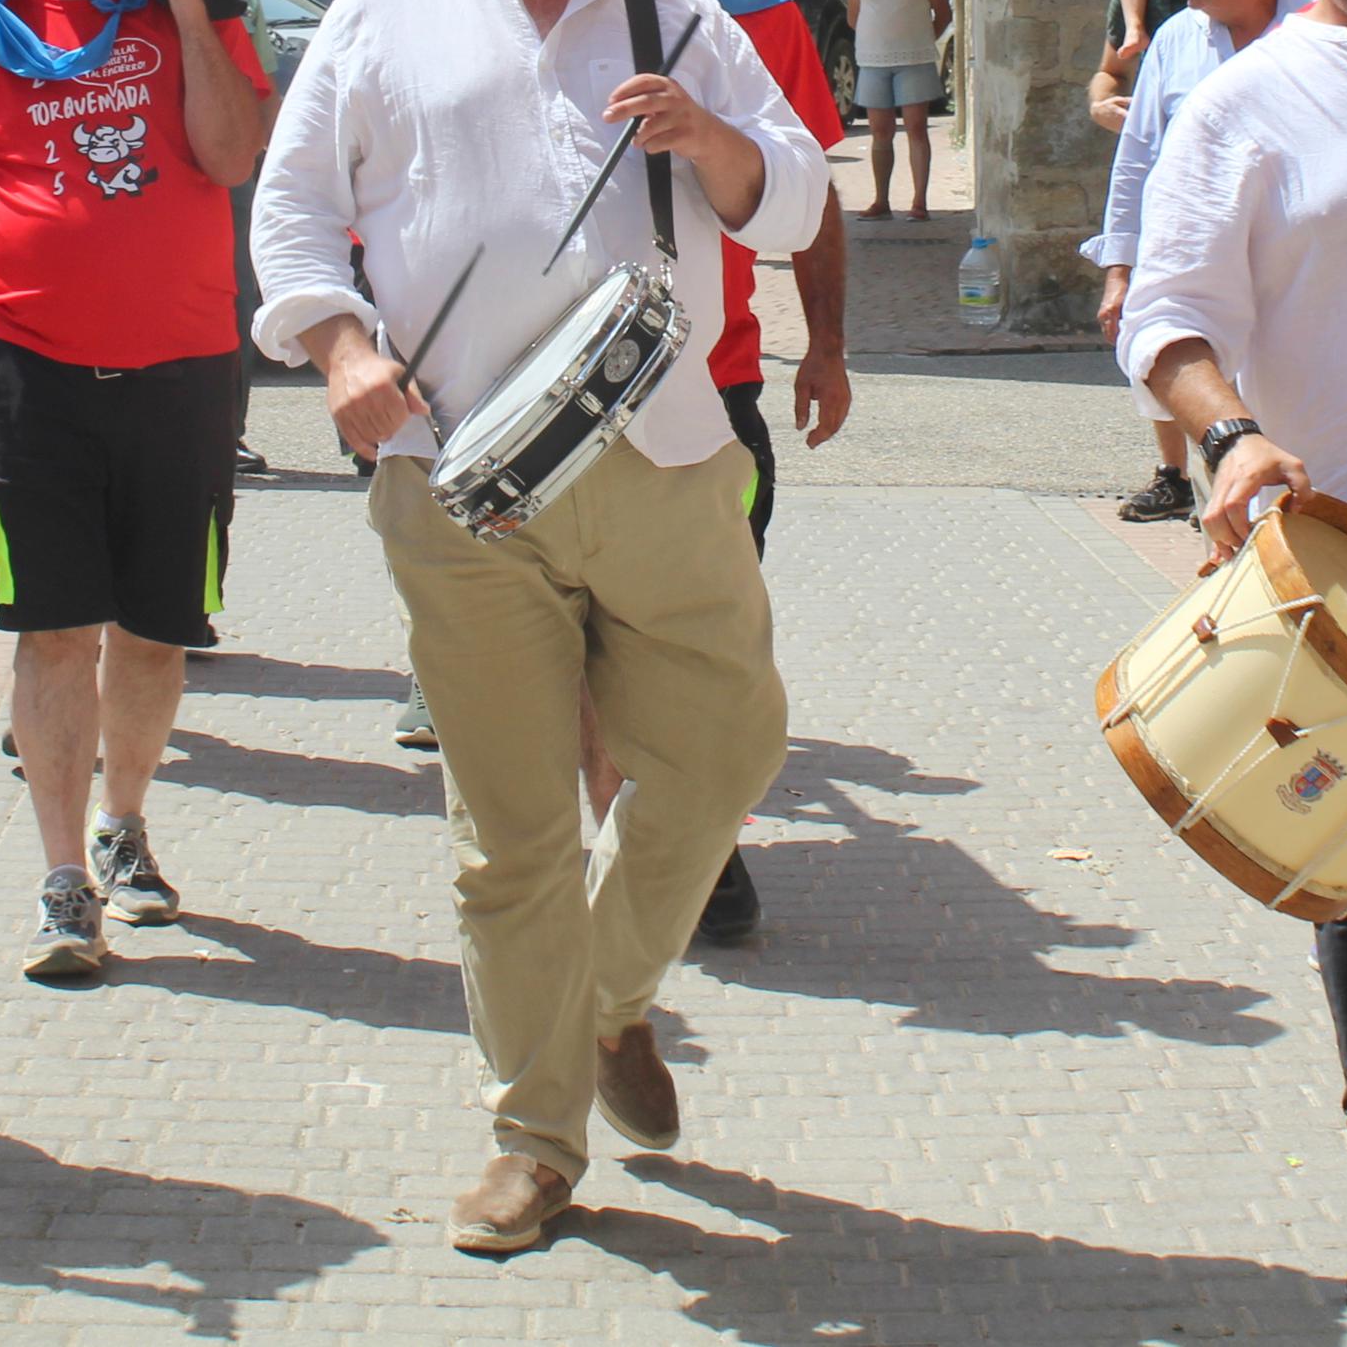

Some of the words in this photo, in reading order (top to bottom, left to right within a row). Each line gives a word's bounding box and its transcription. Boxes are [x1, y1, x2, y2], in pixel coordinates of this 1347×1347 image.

[26, 83, 151, 126] TORQUEMADA
[44, 140, 60, 164] 2
[53, 171, 65, 195] 5
